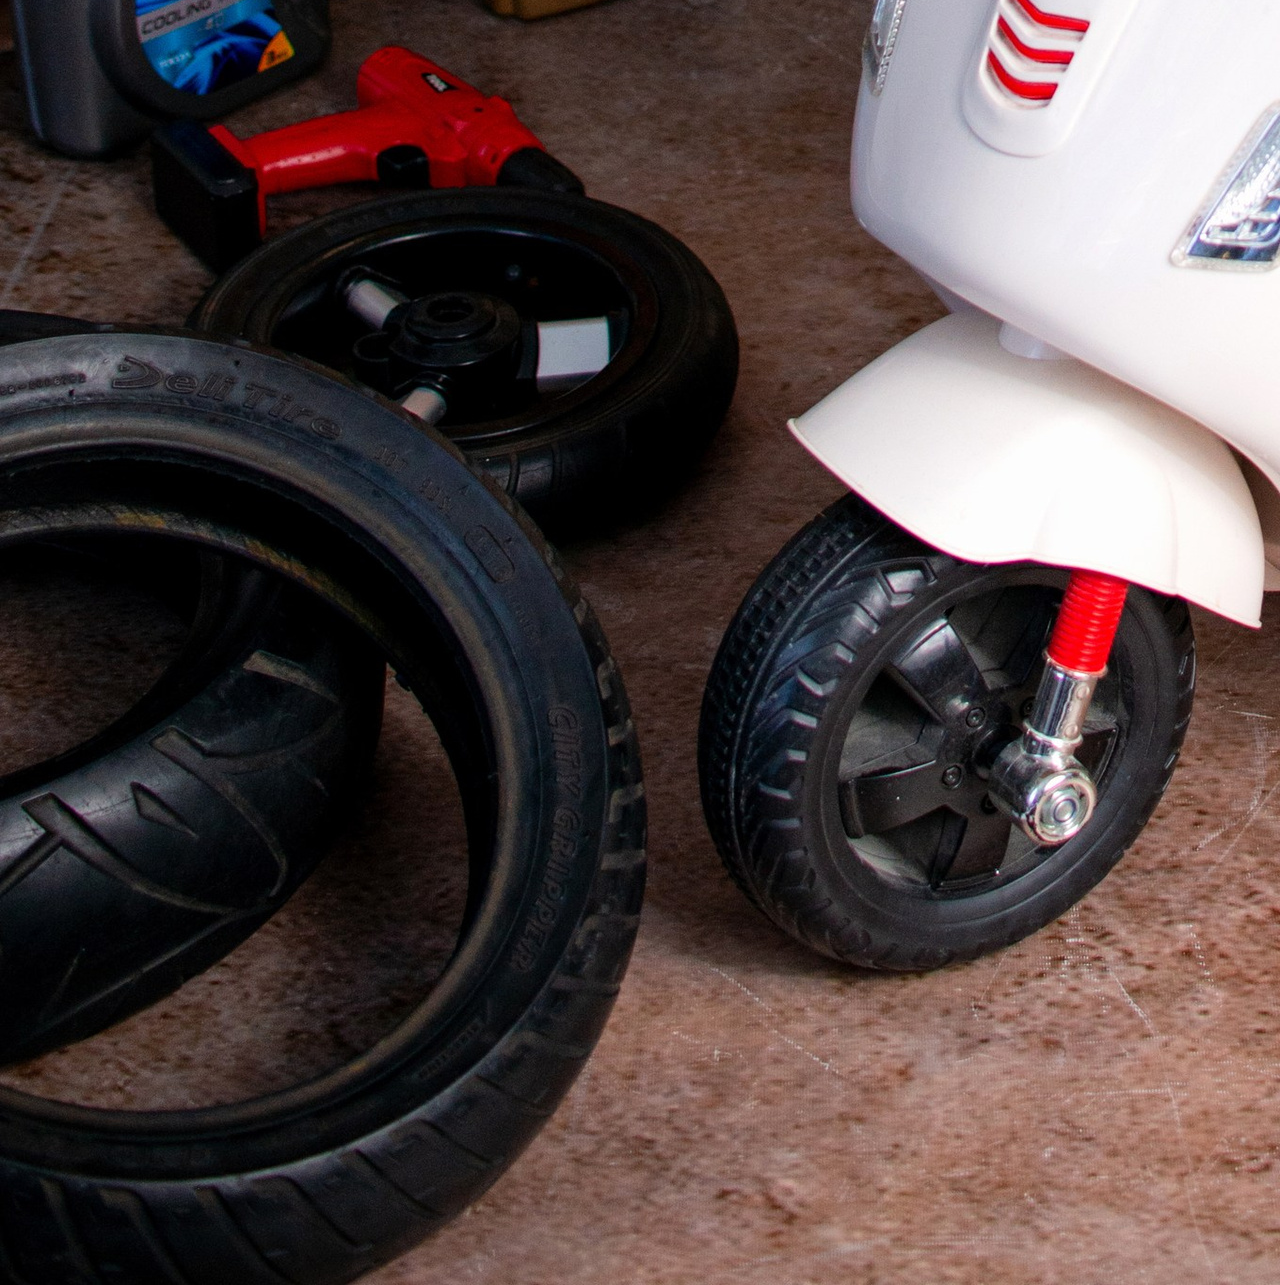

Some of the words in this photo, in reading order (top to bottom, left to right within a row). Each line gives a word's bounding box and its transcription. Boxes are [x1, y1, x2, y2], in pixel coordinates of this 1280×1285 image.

[242, 382, 344, 440] Tire
[546, 705, 583, 798] CITY
[508, 805, 584, 975] GRIPPER
